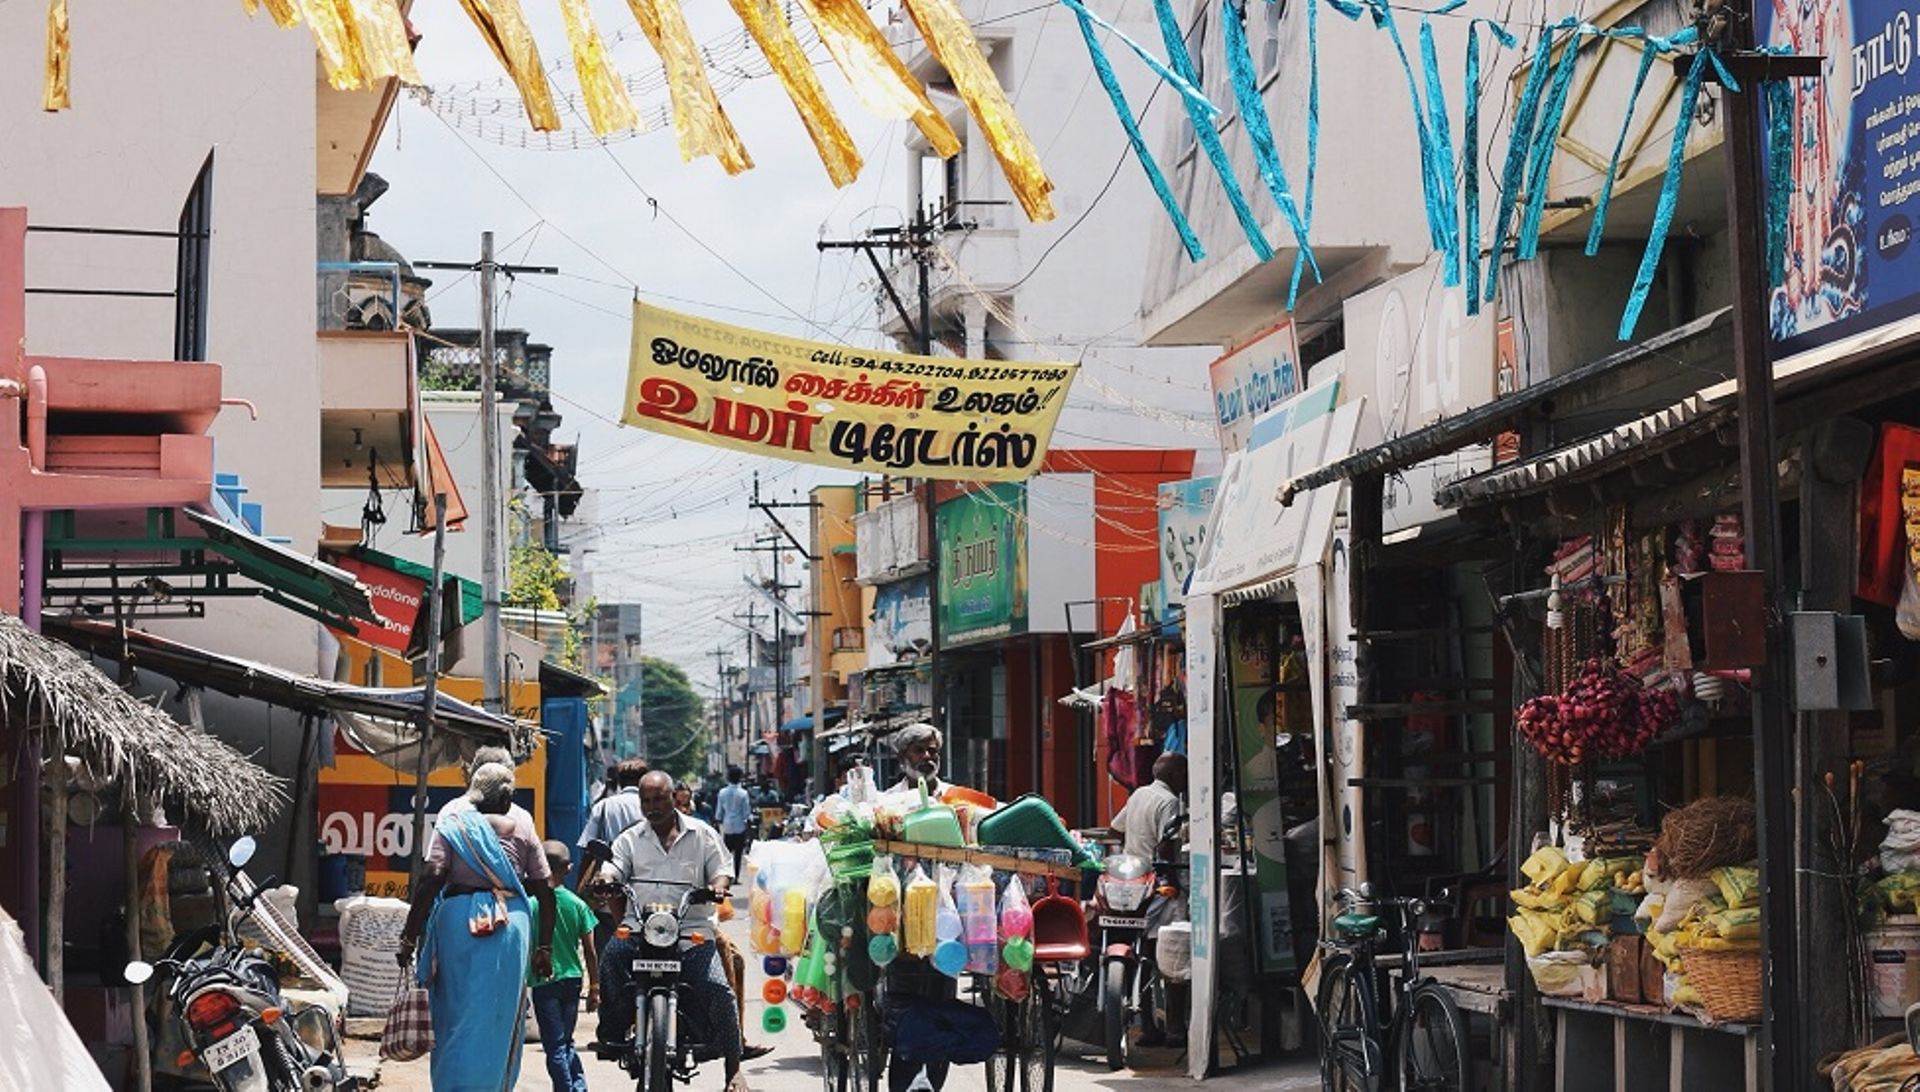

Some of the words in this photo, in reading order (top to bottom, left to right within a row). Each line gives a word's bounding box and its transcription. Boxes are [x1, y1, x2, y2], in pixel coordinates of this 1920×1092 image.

[650, 336, 779, 389] ஓமலூரில்
[784, 372, 928, 411] சைக்கிள்
[636, 376, 824, 453] உமர்
[828, 420, 1037, 469] டிரேடர்ஸ்
